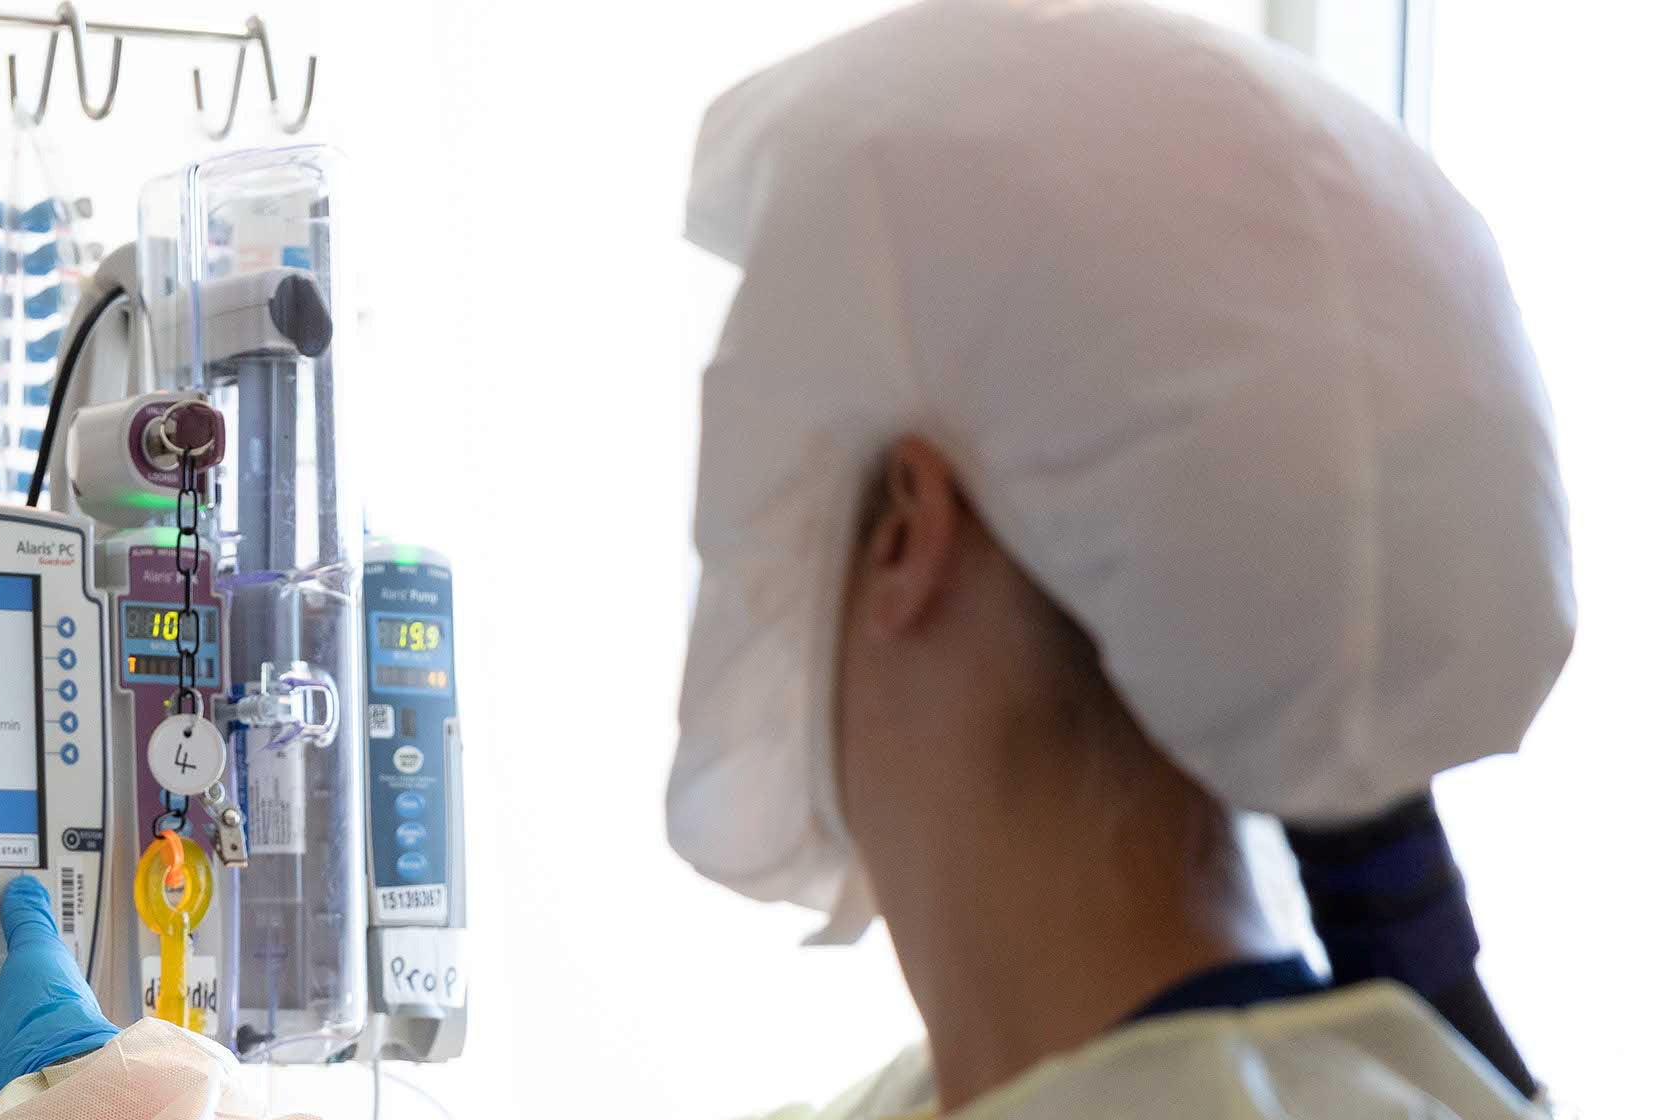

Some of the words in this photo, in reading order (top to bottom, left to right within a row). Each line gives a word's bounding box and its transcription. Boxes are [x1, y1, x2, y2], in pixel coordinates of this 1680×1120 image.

[58, 543, 75, 556] PC
[152, 611, 179, 641] 10
[174, 743, 197, 774] 4
